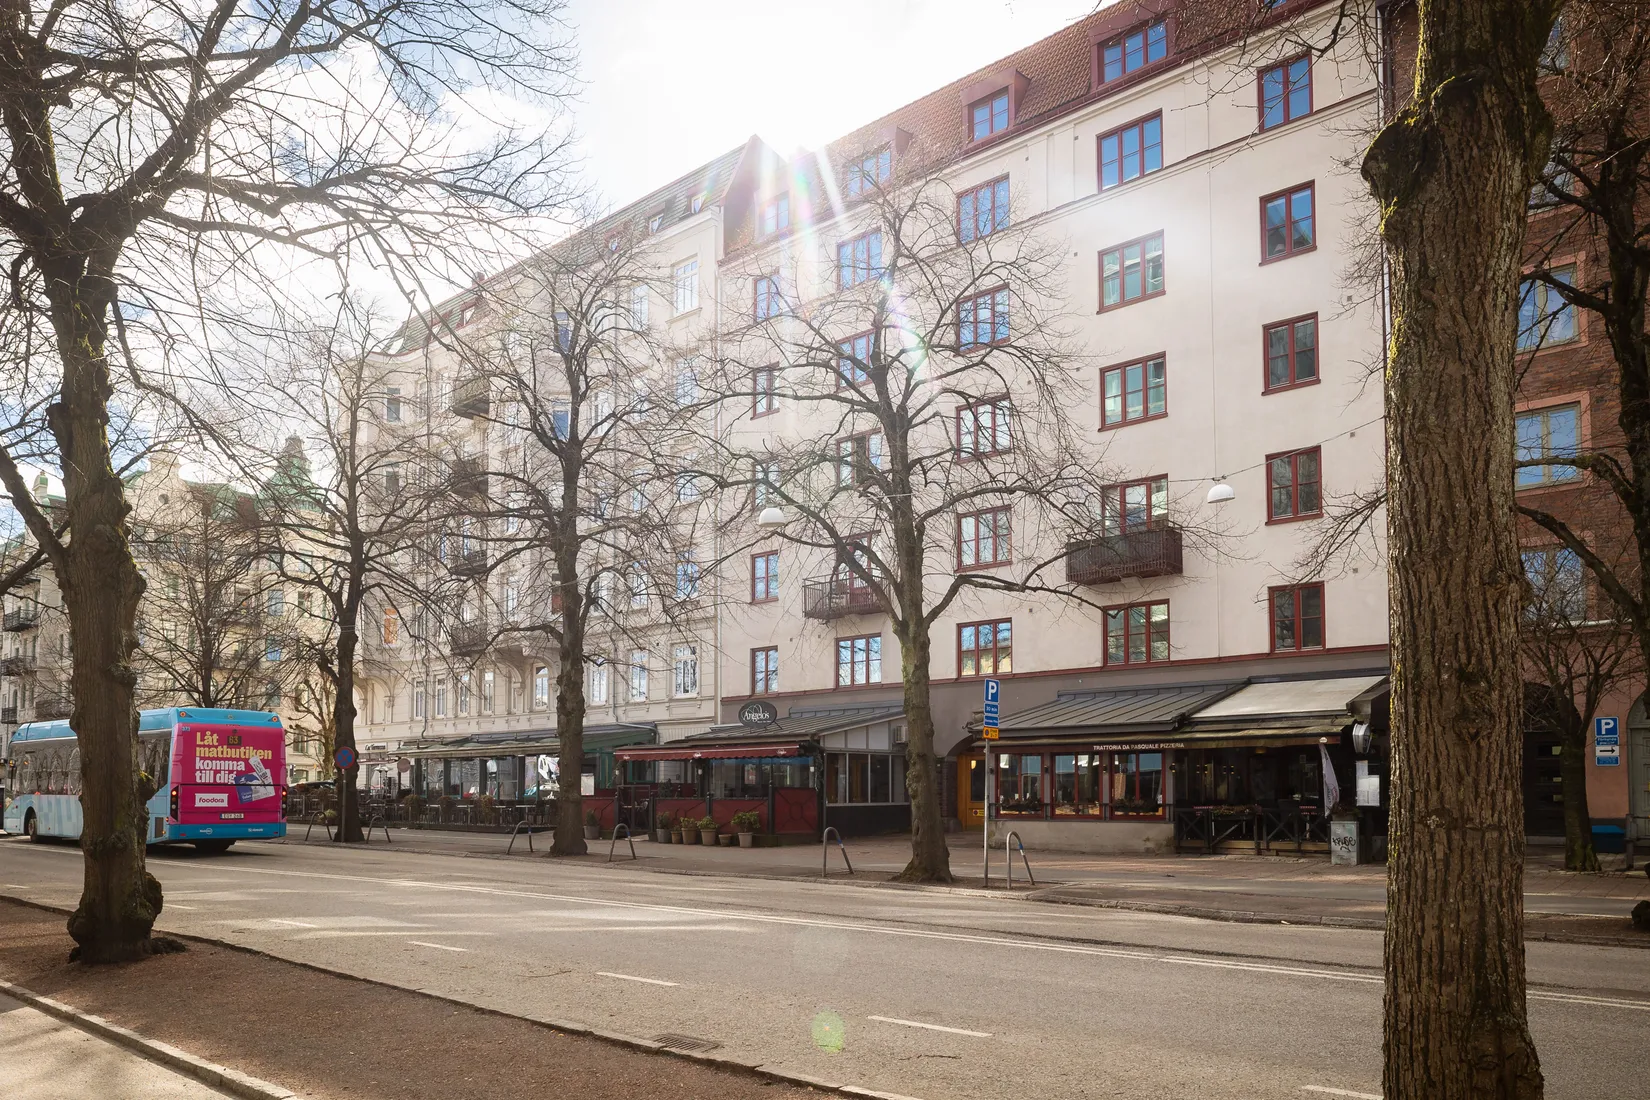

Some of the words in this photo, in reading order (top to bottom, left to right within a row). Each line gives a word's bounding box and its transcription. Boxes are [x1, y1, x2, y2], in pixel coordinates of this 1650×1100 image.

[988, 682, 997, 700] P
[1601, 719, 1614, 735] P
[196, 731, 218, 745] Låt
[228, 736, 238, 744] 63
[196, 746, 272, 760] matbutiken
[196, 757, 245, 770] komma
[195, 770, 214, 783] till
